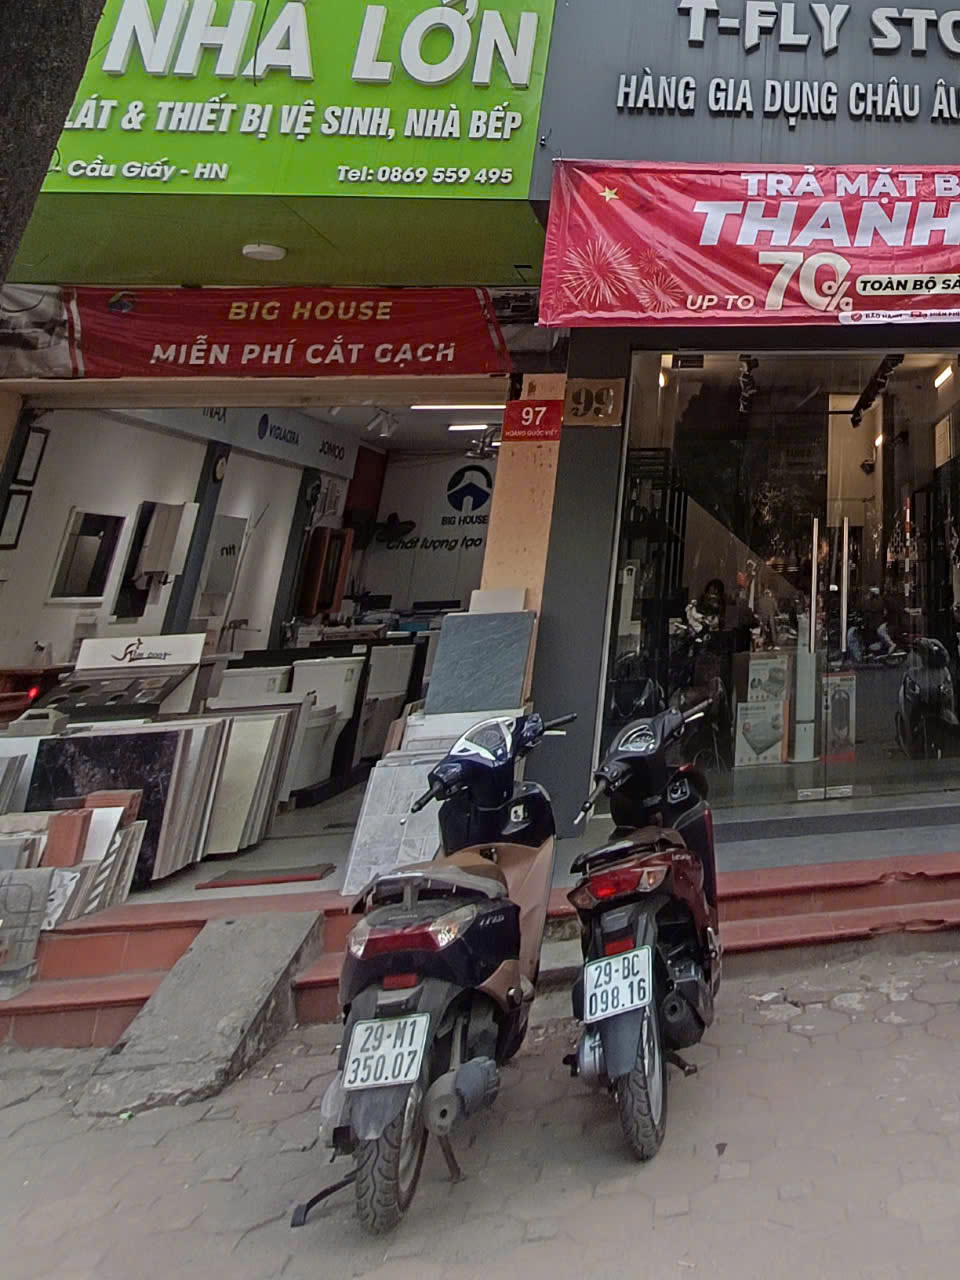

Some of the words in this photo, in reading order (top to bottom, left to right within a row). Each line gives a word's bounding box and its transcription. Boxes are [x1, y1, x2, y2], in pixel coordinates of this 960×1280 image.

[617, 66, 697, 116] HÀNG
[708, 77, 754, 118] GIA
[763, 79, 838, 131] DỤNG
[849, 76, 920, 122] CHÂU
[121, 100, 146, 131] &
[155, 93, 237, 133] THIẾT
[240, 104, 273, 140] BỊ
[280, 100, 314, 141] VỆ
[321, 107, 395, 140] SINH,
[404, 104, 461, 138] NHÀ
[469, 102, 523, 140] BẾP
[67, 154, 116, 178] Cầu
[122, 157, 176, 182] Giấy
[194, 163, 230, 180] HN
[337, 164, 374, 183] Tel:
[377, 166, 428, 184] 0869
[431, 167, 471, 184] 559
[474, 168, 514, 185] 495
[741, 165, 824, 197] TRẢ
[836, 167, 923, 204] MẶT
[758, 251, 853, 313] 70%
[860, 276, 908, 292] TOÀN
[912, 276, 937, 293] BỘ
[228, 300, 281, 321] BIG
[291, 299, 393, 321] HOUSE
[686, 293, 721, 312] UP
[724, 293, 755, 311] TO
[150, 335, 228, 366] MIỄN
[241, 340, 296, 365] PHÍ
[307, 340, 363, 365] CẮT
[375, 342, 456, 368] GẠCH
[521, 406, 547, 425] 97
[571, 387, 614, 417] 99
[441, 515, 456, 525] BIG
[458, 515, 489, 526] HOUSE
[594, 953, 640, 990] 29-BC
[588, 977, 648, 1018] 098.16
[347, 1049, 418, 1084] 350.07
